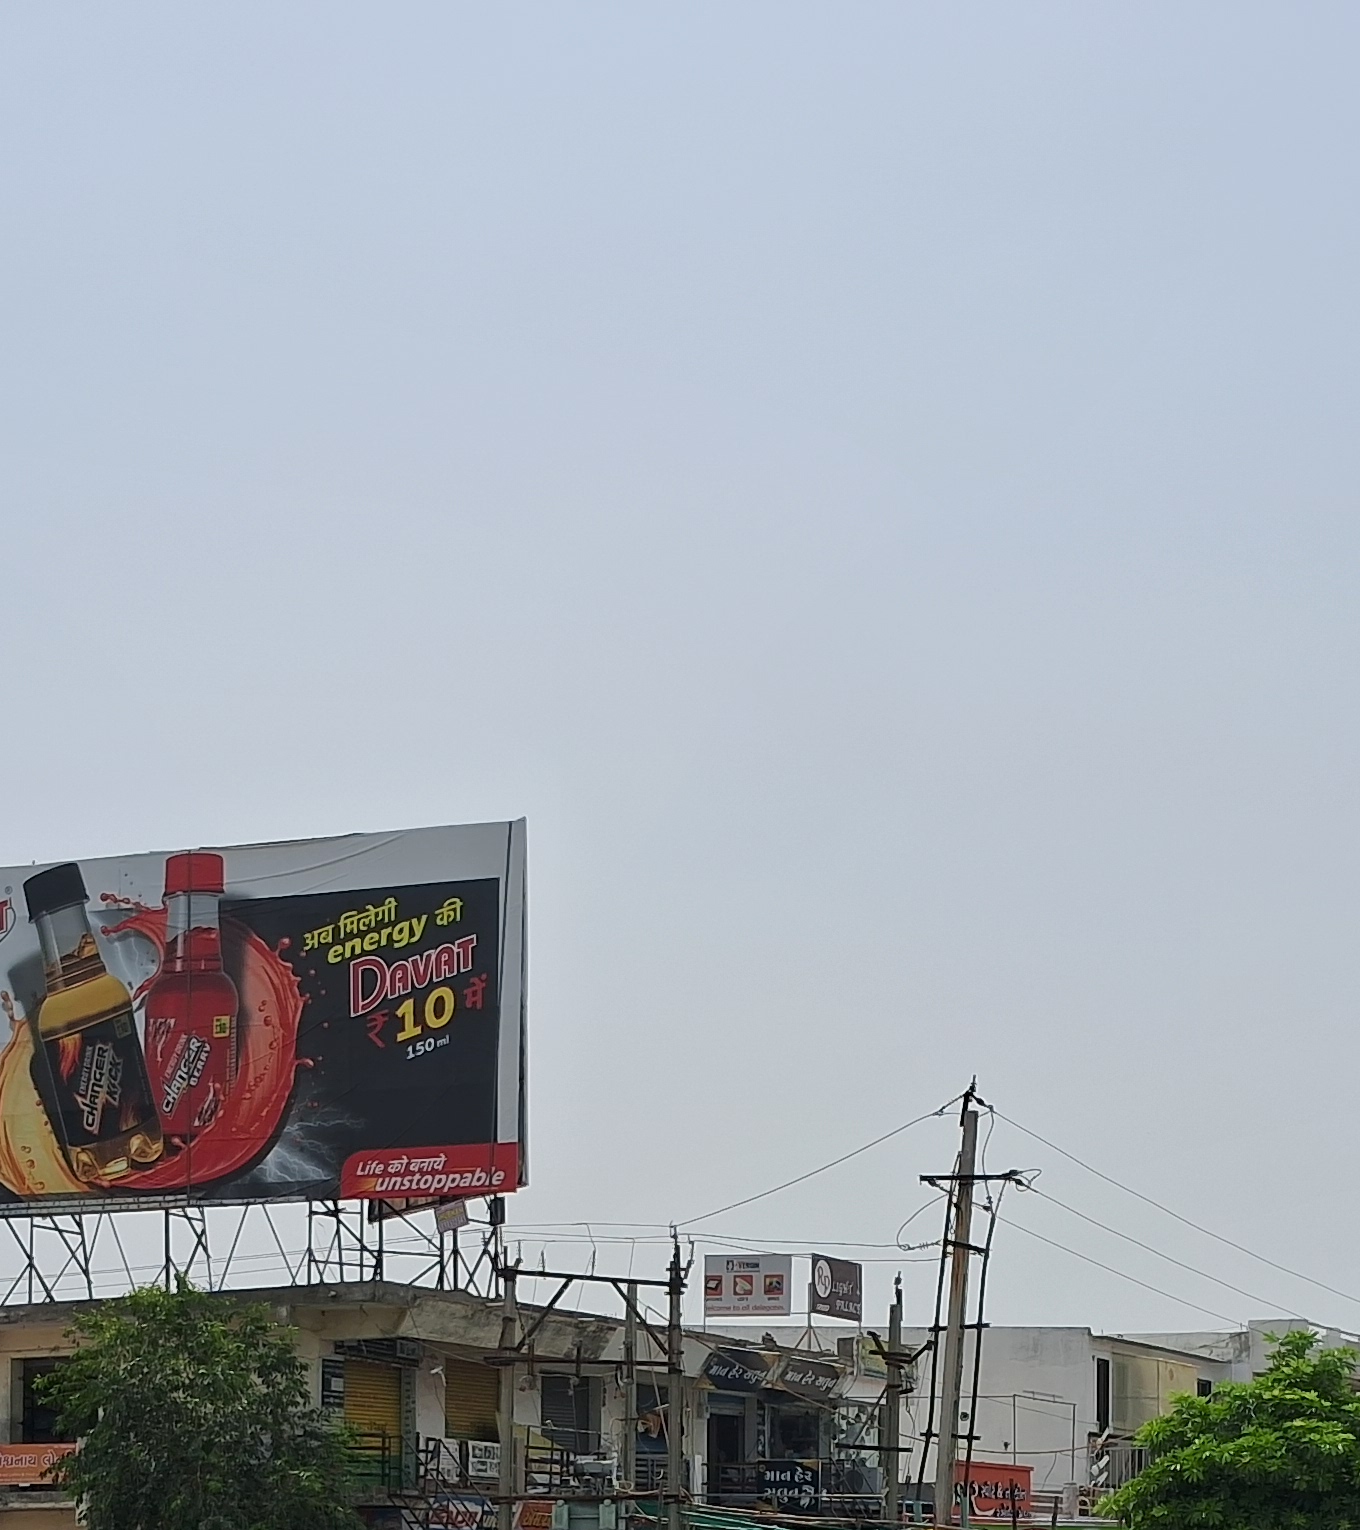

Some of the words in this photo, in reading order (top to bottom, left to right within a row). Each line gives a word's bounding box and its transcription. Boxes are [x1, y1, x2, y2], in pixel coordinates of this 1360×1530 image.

[303, 923, 335, 951] अब
[338, 897, 398, 939] मिलेगी
[327, 914, 427, 964] energy
[435, 897, 463, 926] की
[349, 934, 477, 1018] DAVAT
[406, 1037, 435, 1060] 150
[357, 1160, 385, 1176] Life
[387, 1155, 408, 1175] को
